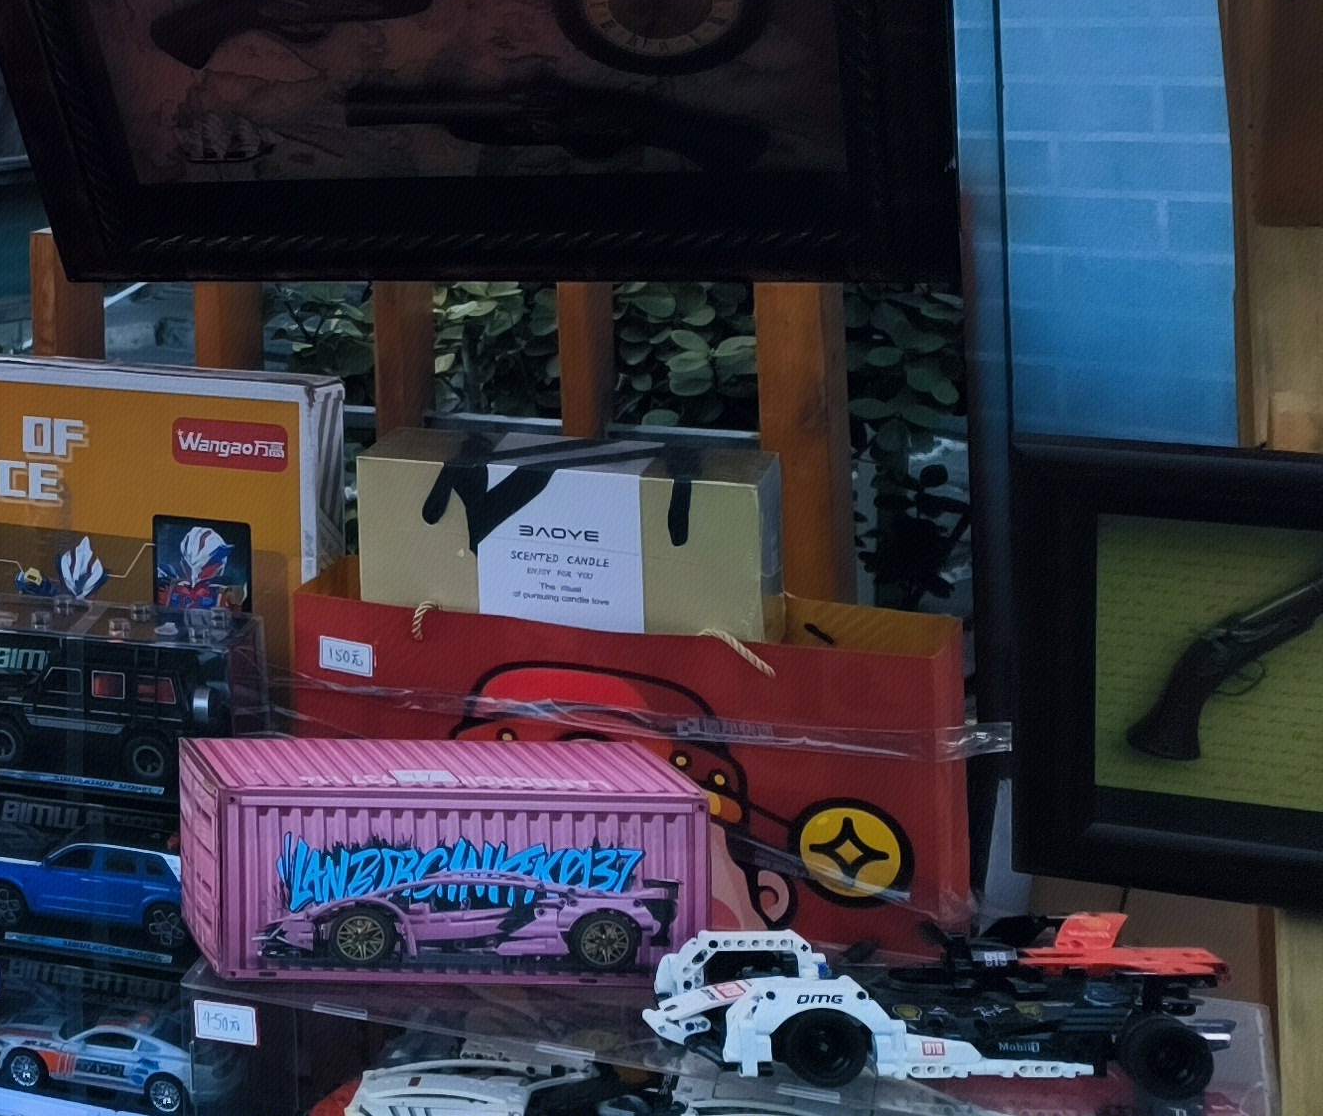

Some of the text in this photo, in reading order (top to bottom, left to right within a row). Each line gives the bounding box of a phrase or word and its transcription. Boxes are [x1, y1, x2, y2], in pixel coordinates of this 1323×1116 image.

[21, 414, 87, 459] OF
[510, 550, 610, 568] SCENTED CANDLE
[526, 567, 594, 580] ENJOY FOR YOU
[539, 581, 556, 591] The
[512, 590, 610, 606] of pursuing candle love
[329, 647, 364, 667] 150元
